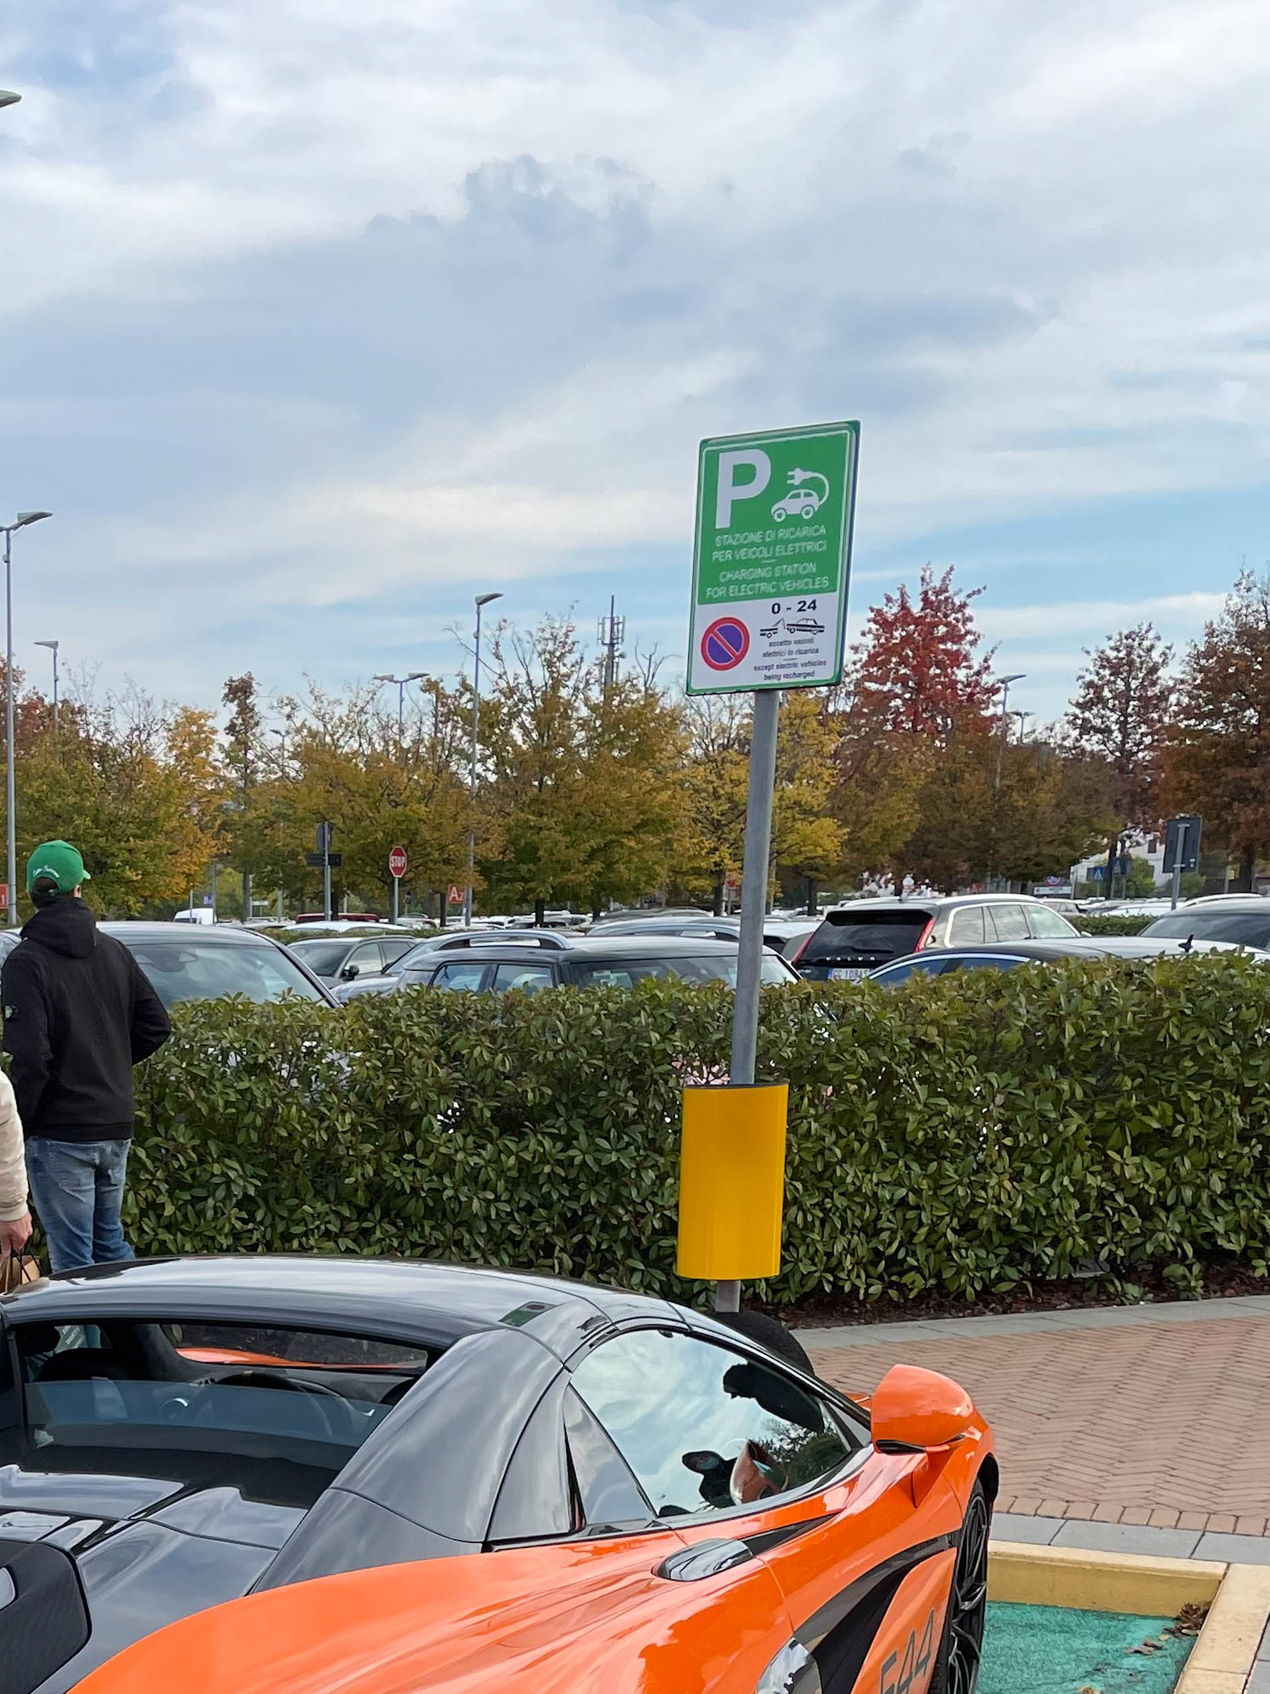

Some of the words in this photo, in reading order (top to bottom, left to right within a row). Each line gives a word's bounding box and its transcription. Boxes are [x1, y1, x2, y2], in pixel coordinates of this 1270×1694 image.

[715, 449, 771, 529] P
[715, 531, 763, 547] STAZIONE
[766, 529, 776, 541] DI
[778, 525, 826, 540] RICARICA
[712, 550, 733, 562] PER
[734, 546, 773, 560] VEICOLI
[775, 540, 827, 557] ELETTRICI
[719, 567, 772, 582] CHARGING
[775, 562, 817, 577] STATION
[706, 586, 727, 599] FOR
[729, 581, 777, 597] ELECTRIC
[778, 576, 829, 591] VEHICLES
[771, 602, 781, 614] 0
[797, 599, 817, 612] 24
[754, 663, 775, 671] except
[800, 660, 827, 668] vehicles
[764, 673, 782, 681] being
[783, 670, 815, 679] recharged
[390, 856, 406, 867] STOP
[449, 886, 464, 901] A2
